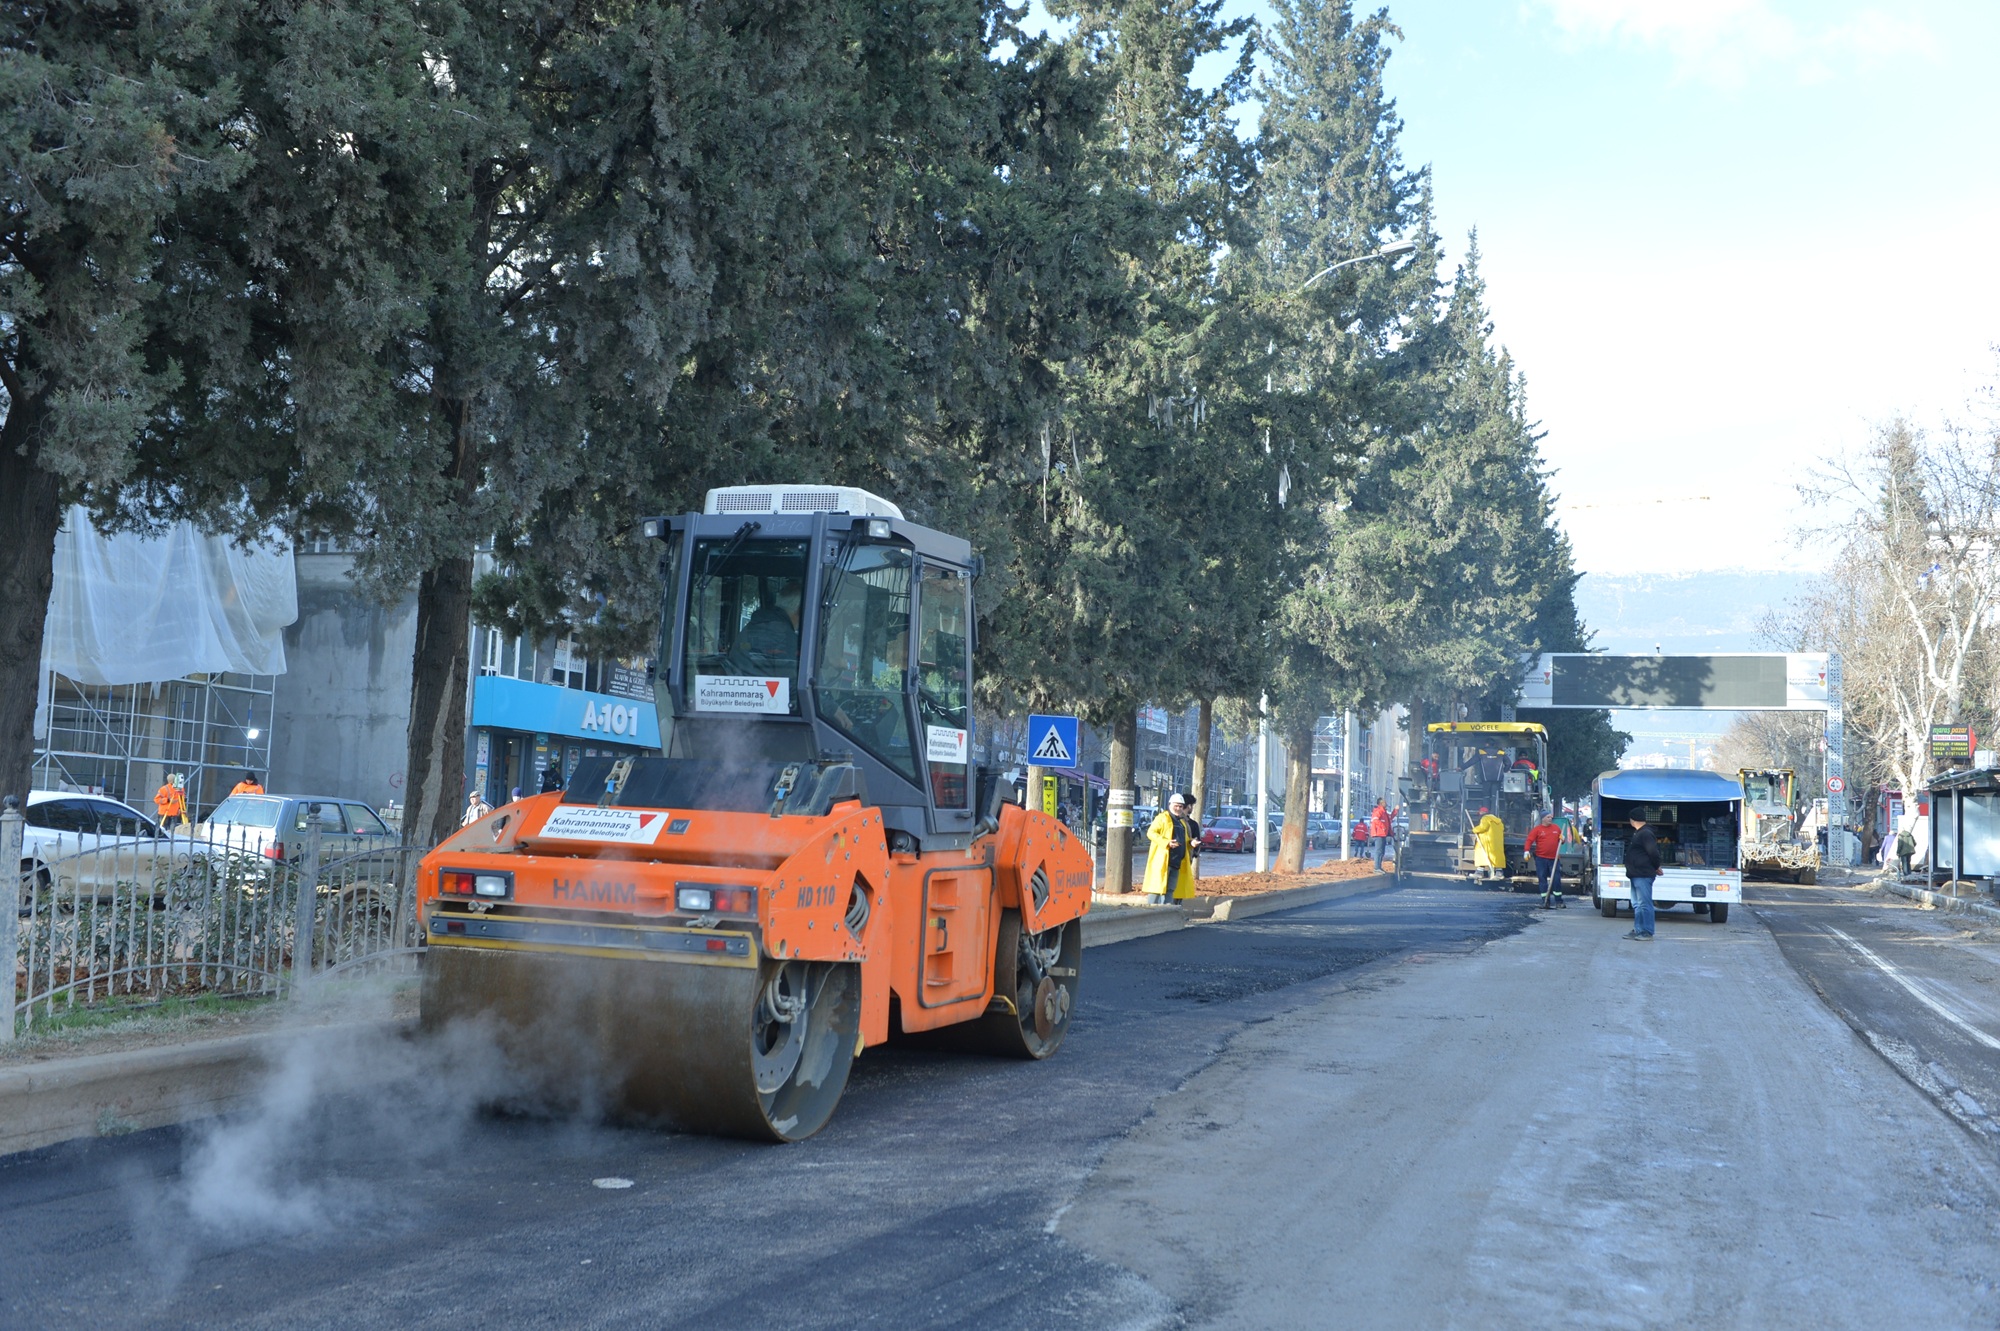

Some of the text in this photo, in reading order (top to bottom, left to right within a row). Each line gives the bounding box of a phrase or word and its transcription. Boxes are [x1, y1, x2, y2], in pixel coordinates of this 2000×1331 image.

[700, 689, 764, 700] Kahramanmaraş
[700, 698, 765, 708] Büyükşehir Belediyesi
[552, 817, 631, 831] Kahramanmaraş
[547, 826, 628, 838] Büyükşehir Belediyesi
[1066, 871, 1090, 888] HAMM
[553, 878, 636, 904] HAMM
[797, 884, 836, 908] HD 110
